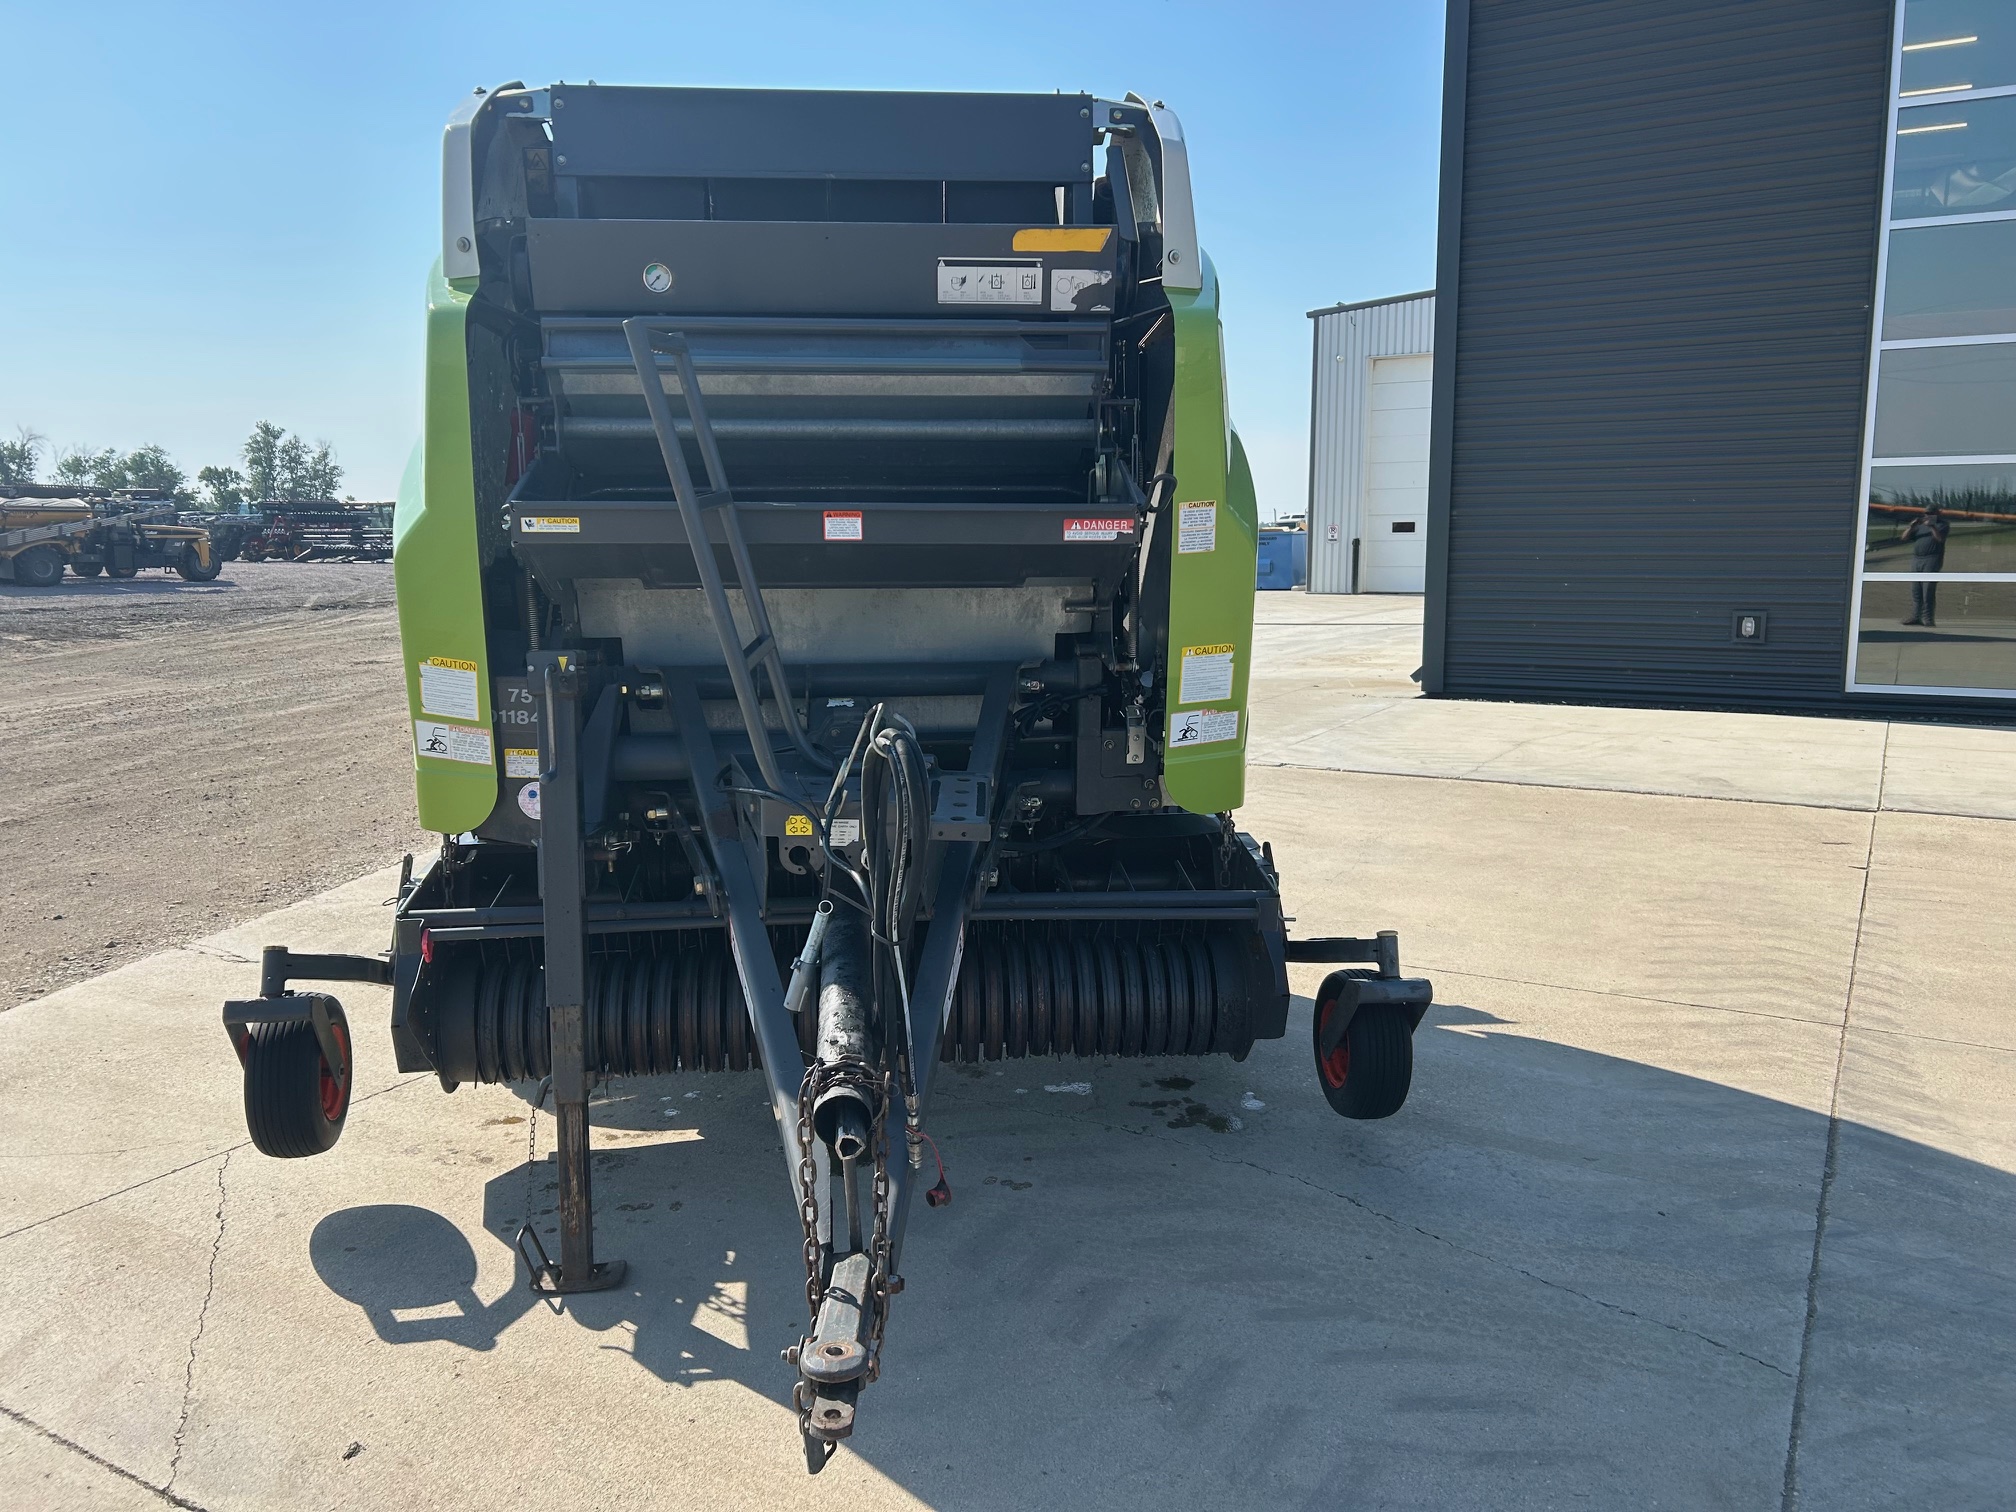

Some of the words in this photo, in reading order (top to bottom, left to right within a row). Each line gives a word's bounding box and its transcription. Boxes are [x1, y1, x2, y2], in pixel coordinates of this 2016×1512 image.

[1084, 520, 1128, 530] DANGER
[1194, 644, 1234, 656] CAUTION
[432, 658, 476, 671] CAUTION
[508, 688, 532, 704] 75
[460, 726, 488, 736] DANGER
